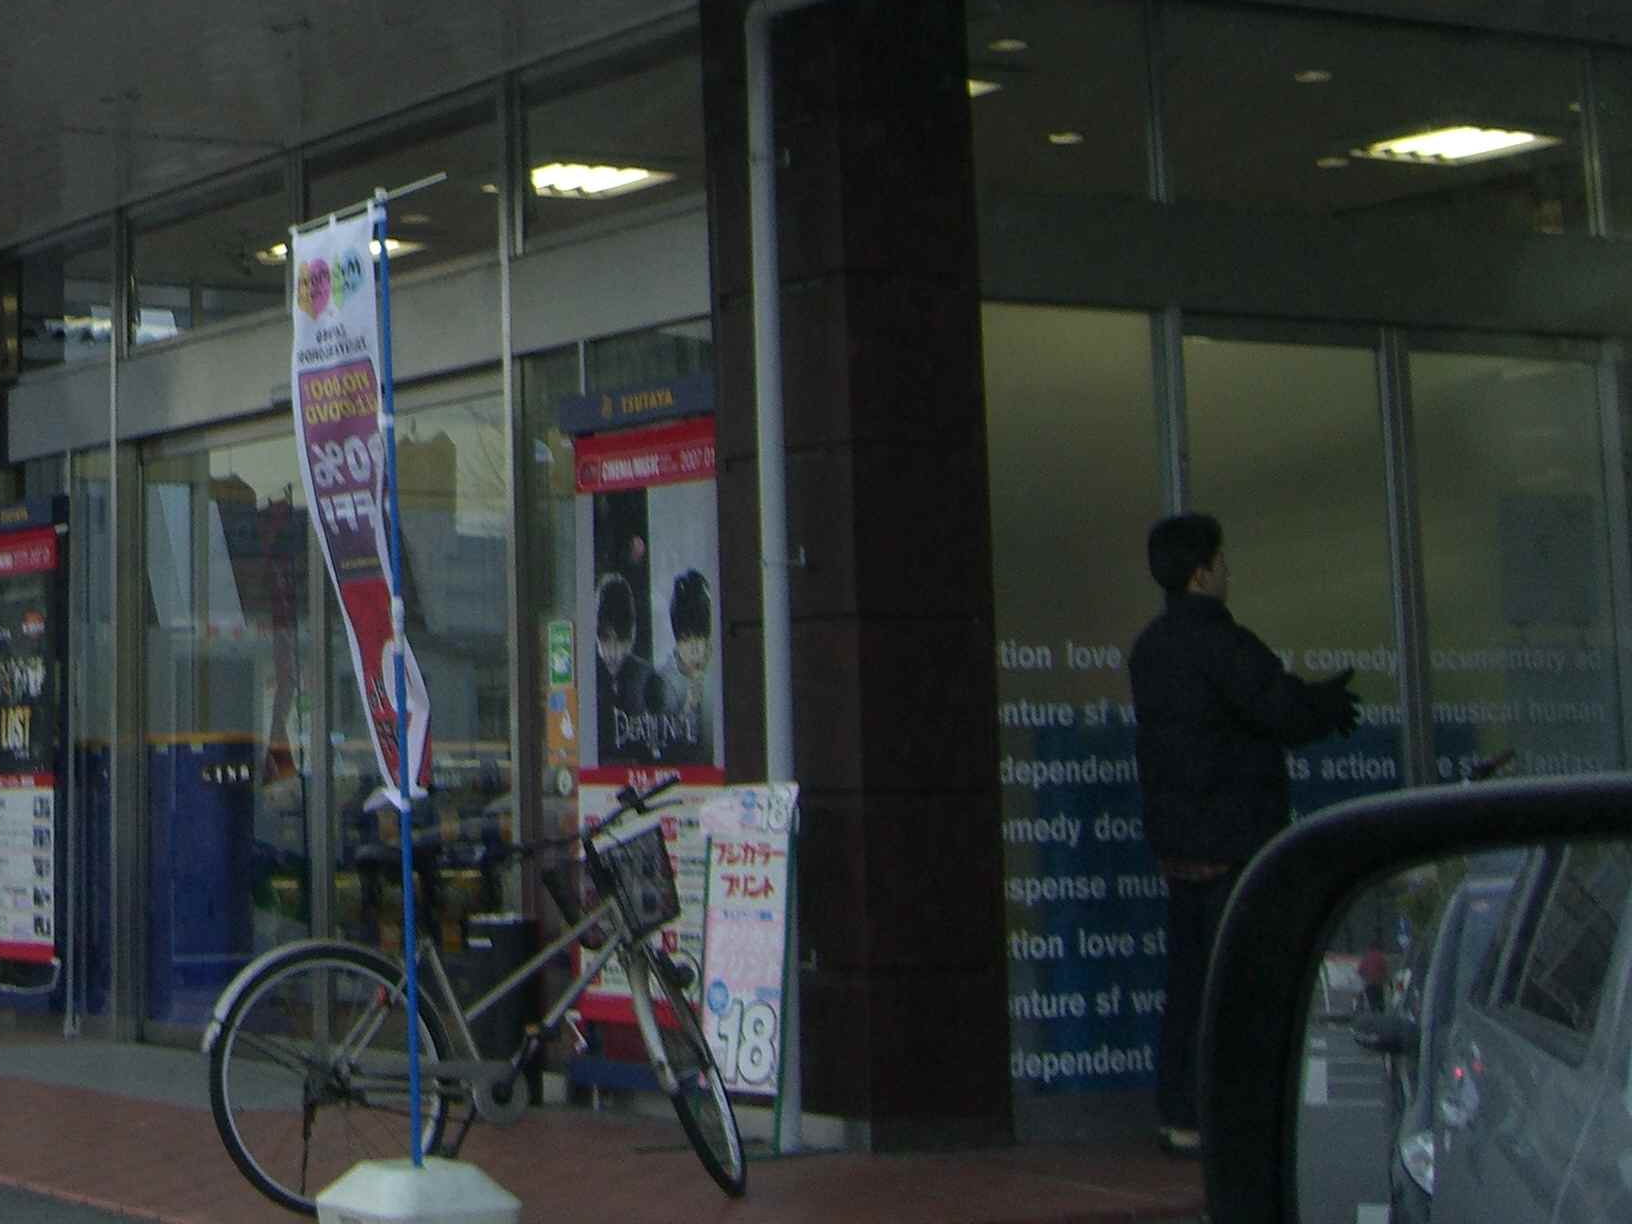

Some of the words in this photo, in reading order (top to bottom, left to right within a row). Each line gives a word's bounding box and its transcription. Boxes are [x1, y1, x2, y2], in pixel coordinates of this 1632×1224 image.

[621, 387, 673, 413] TSUTAYA
[1065, 640, 1121, 669] love
[1320, 752, 1396, 780] action
[1079, 927, 1135, 959] love
[718, 1000, 778, 1084] 18
[1010, 1043, 1156, 1085] dependent
